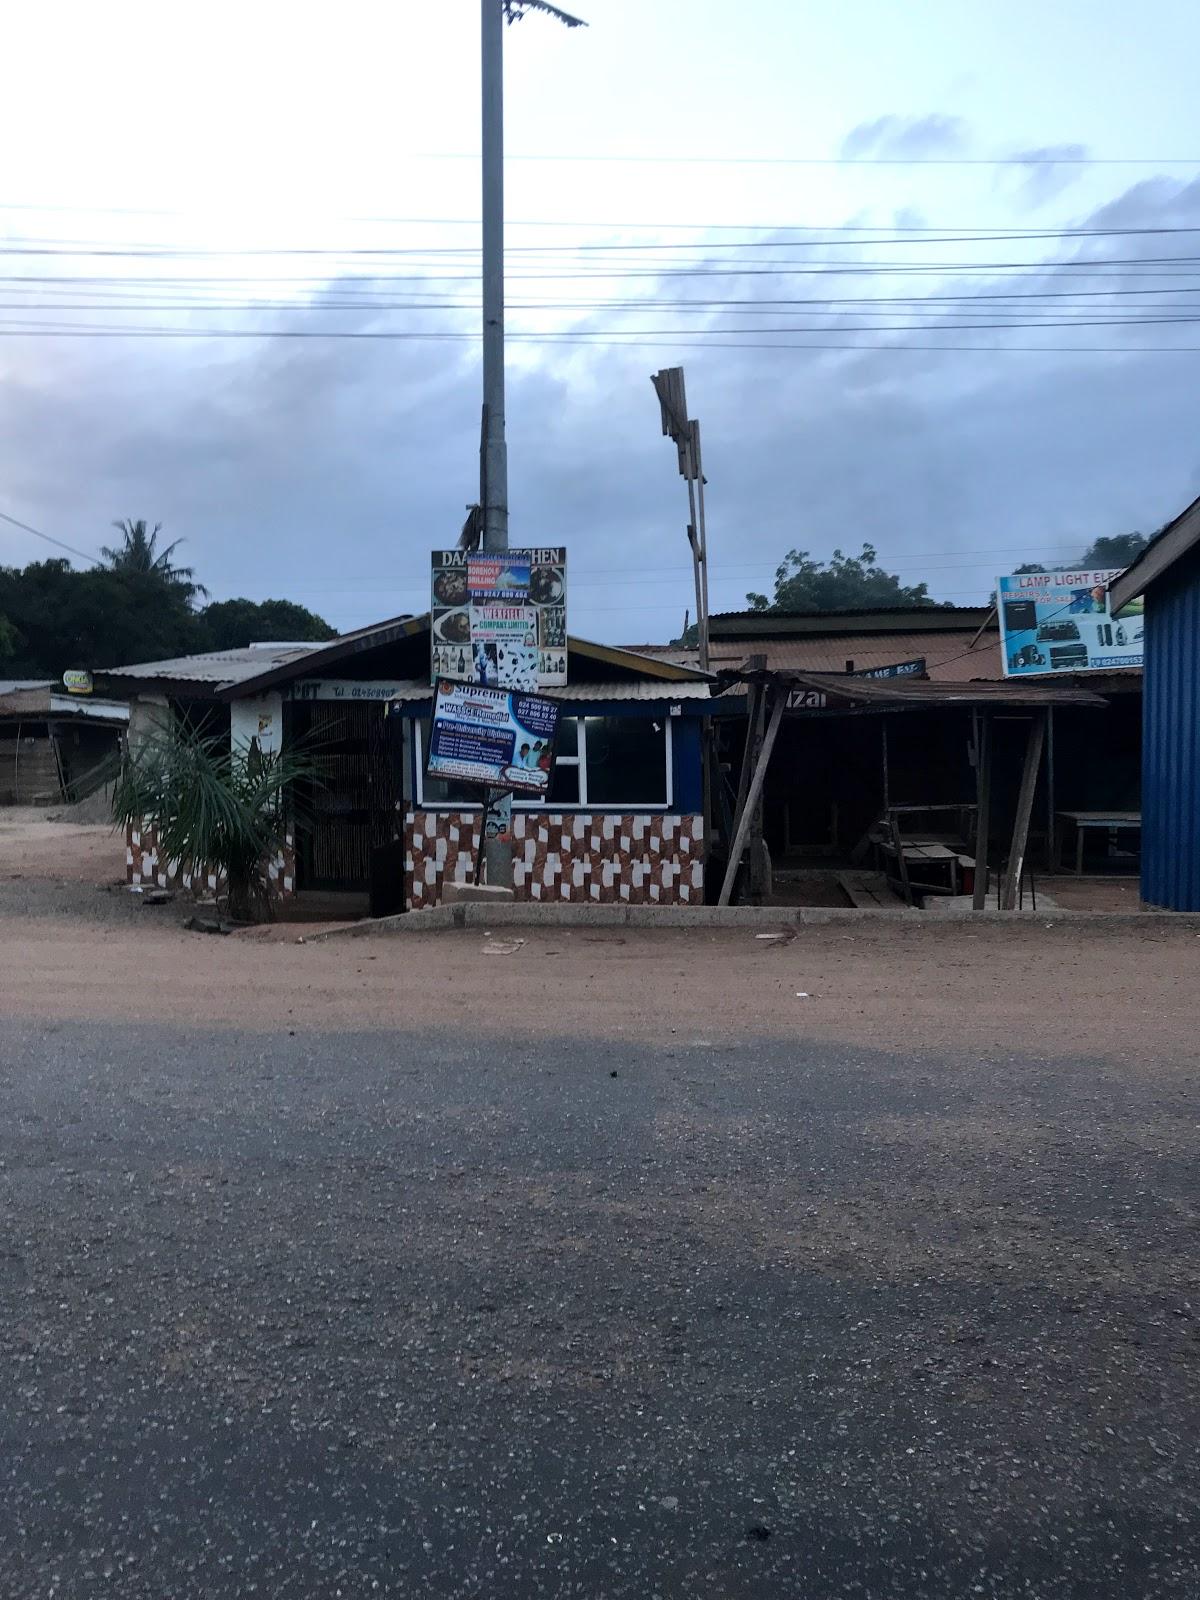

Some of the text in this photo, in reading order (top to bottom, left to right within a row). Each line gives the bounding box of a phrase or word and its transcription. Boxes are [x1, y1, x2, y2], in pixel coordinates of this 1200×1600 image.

[1019, 576, 1050, 588] LAMP
[1055, 574, 1088, 586] LIGHT
[455, 684, 507, 700] Supreme
[445, 702, 476, 717] WASSCE
[476, 709, 510, 722] Remedial
